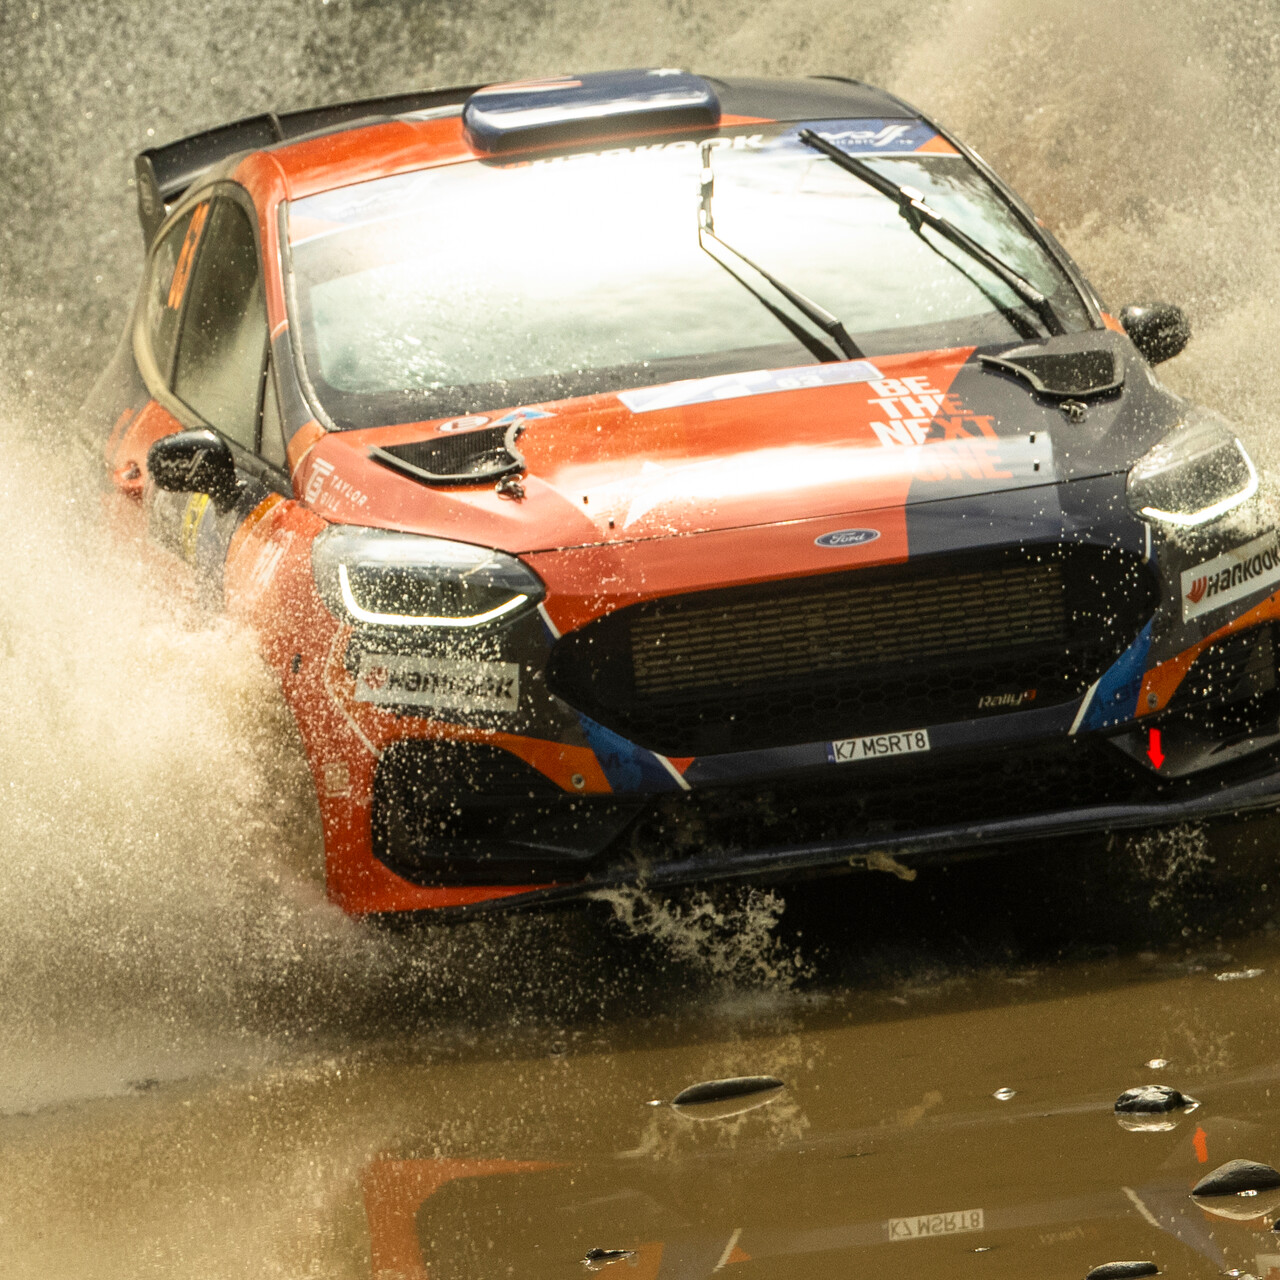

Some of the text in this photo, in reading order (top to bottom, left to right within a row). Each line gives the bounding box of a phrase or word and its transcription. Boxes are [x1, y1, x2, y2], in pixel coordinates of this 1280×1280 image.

[867, 376, 941, 397] BE
[867, 394, 974, 419] THE
[869, 415, 1001, 447] NEXT
[320, 492, 341, 512] GILL
[329, 475, 368, 507] TAYLOR
[835, 732, 926, 760] K7 MSRT8
